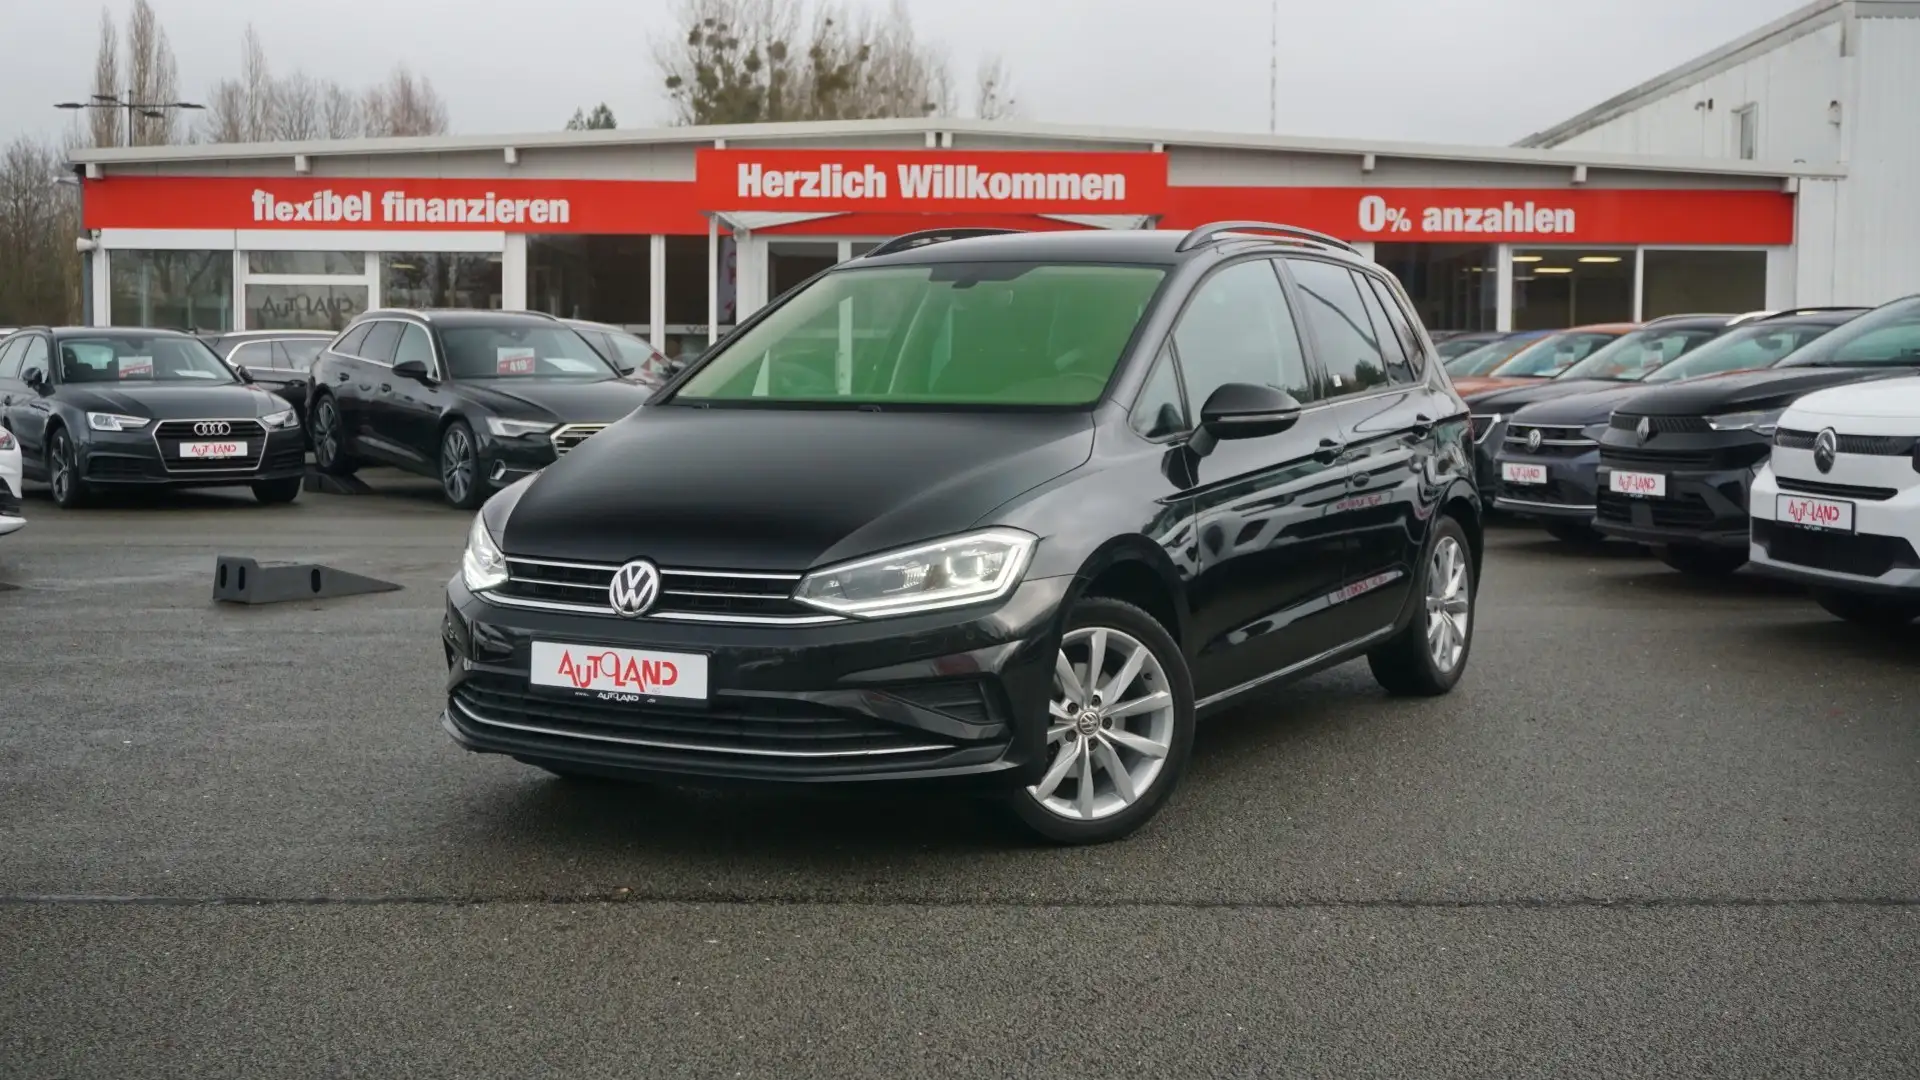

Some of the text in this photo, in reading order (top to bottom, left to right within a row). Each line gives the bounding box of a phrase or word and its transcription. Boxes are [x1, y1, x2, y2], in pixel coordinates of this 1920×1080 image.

[738, 163, 1126, 201] Herzlich Willkommen
[251, 189, 570, 224] flexibel finanzieren
[1358, 195, 1575, 233] 0% anzahlen
[1510, 467, 1540, 480] AUTLAND
[1788, 500, 1840, 524] AUTOLAND
[557, 650, 679, 693] AUTOLAND
